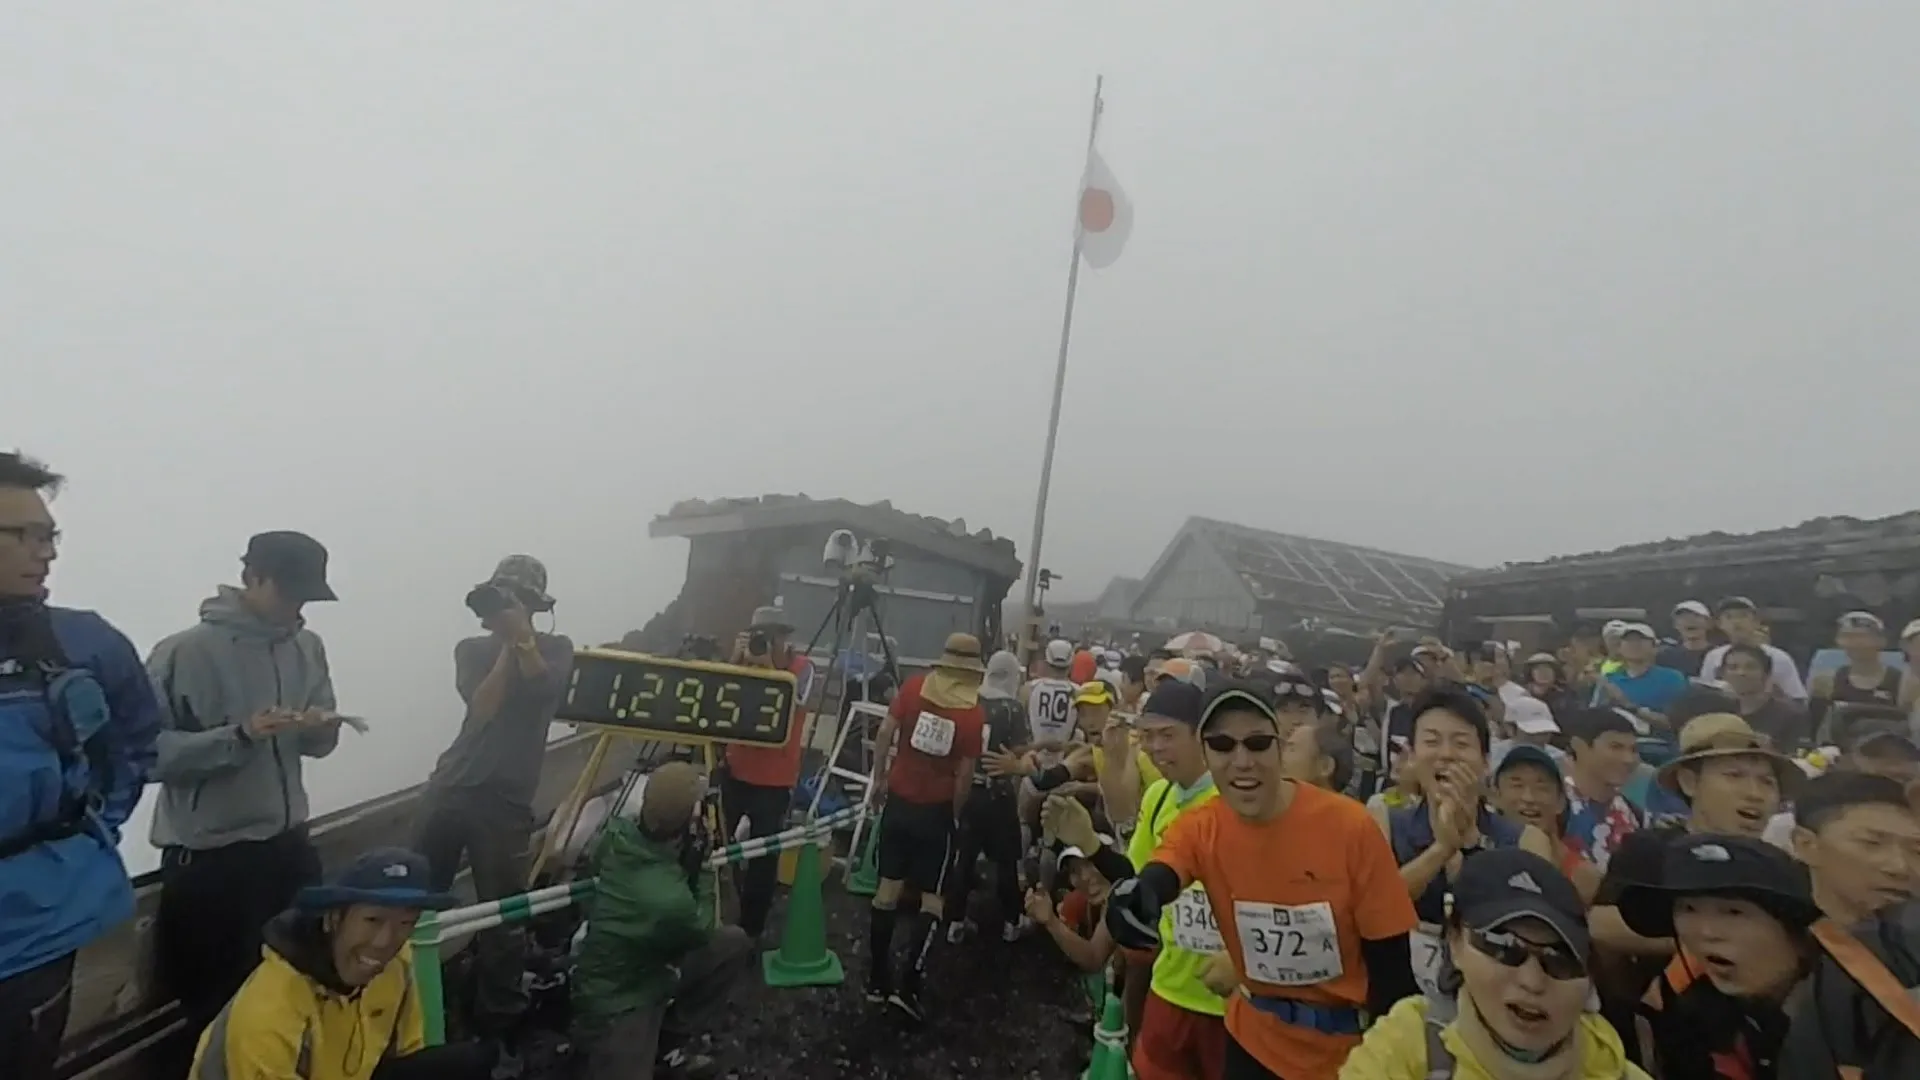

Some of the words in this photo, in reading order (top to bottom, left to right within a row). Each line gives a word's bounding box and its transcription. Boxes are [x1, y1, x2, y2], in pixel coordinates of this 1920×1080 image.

[1039, 691, 1068, 720] RC
[1250, 928, 1308, 957] 372
[1322, 937, 1334, 952] A
